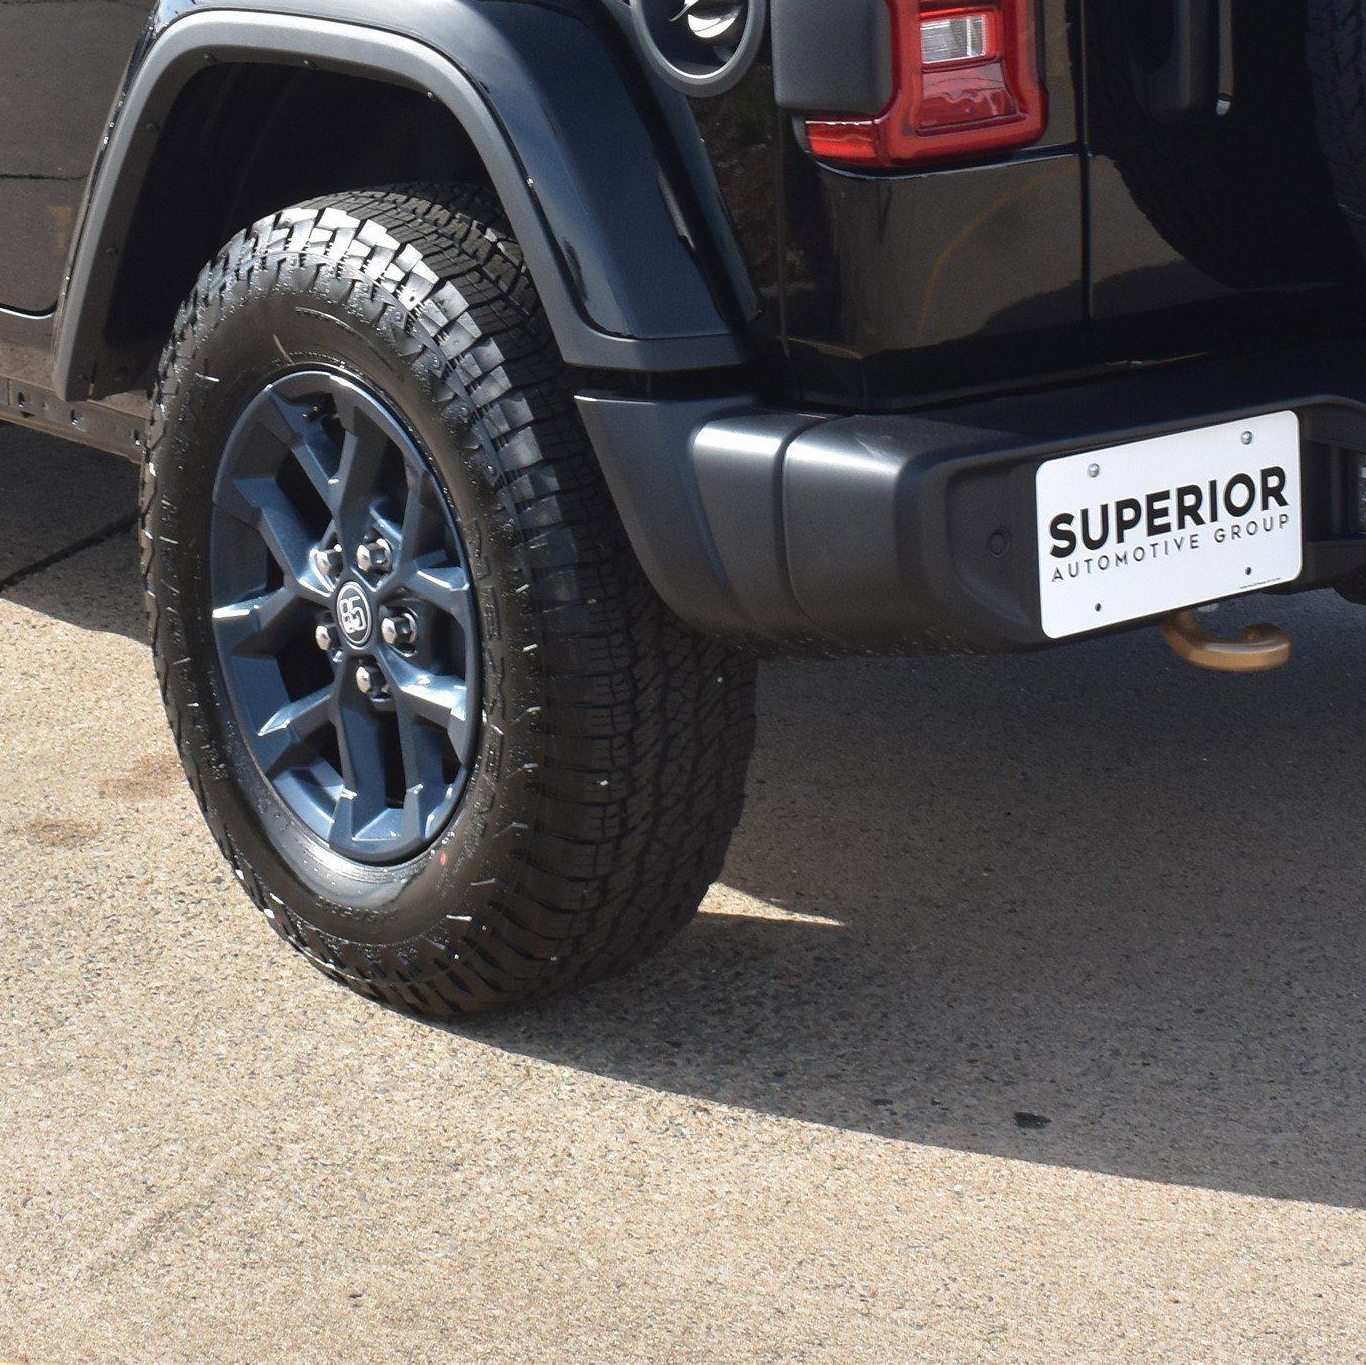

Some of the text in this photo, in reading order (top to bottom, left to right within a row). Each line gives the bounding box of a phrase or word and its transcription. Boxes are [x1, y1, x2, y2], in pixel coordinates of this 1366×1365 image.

[1048, 465, 1289, 559] SUPERIOR
[1051, 513, 1290, 582] AUTOMOTIVE GROUP
